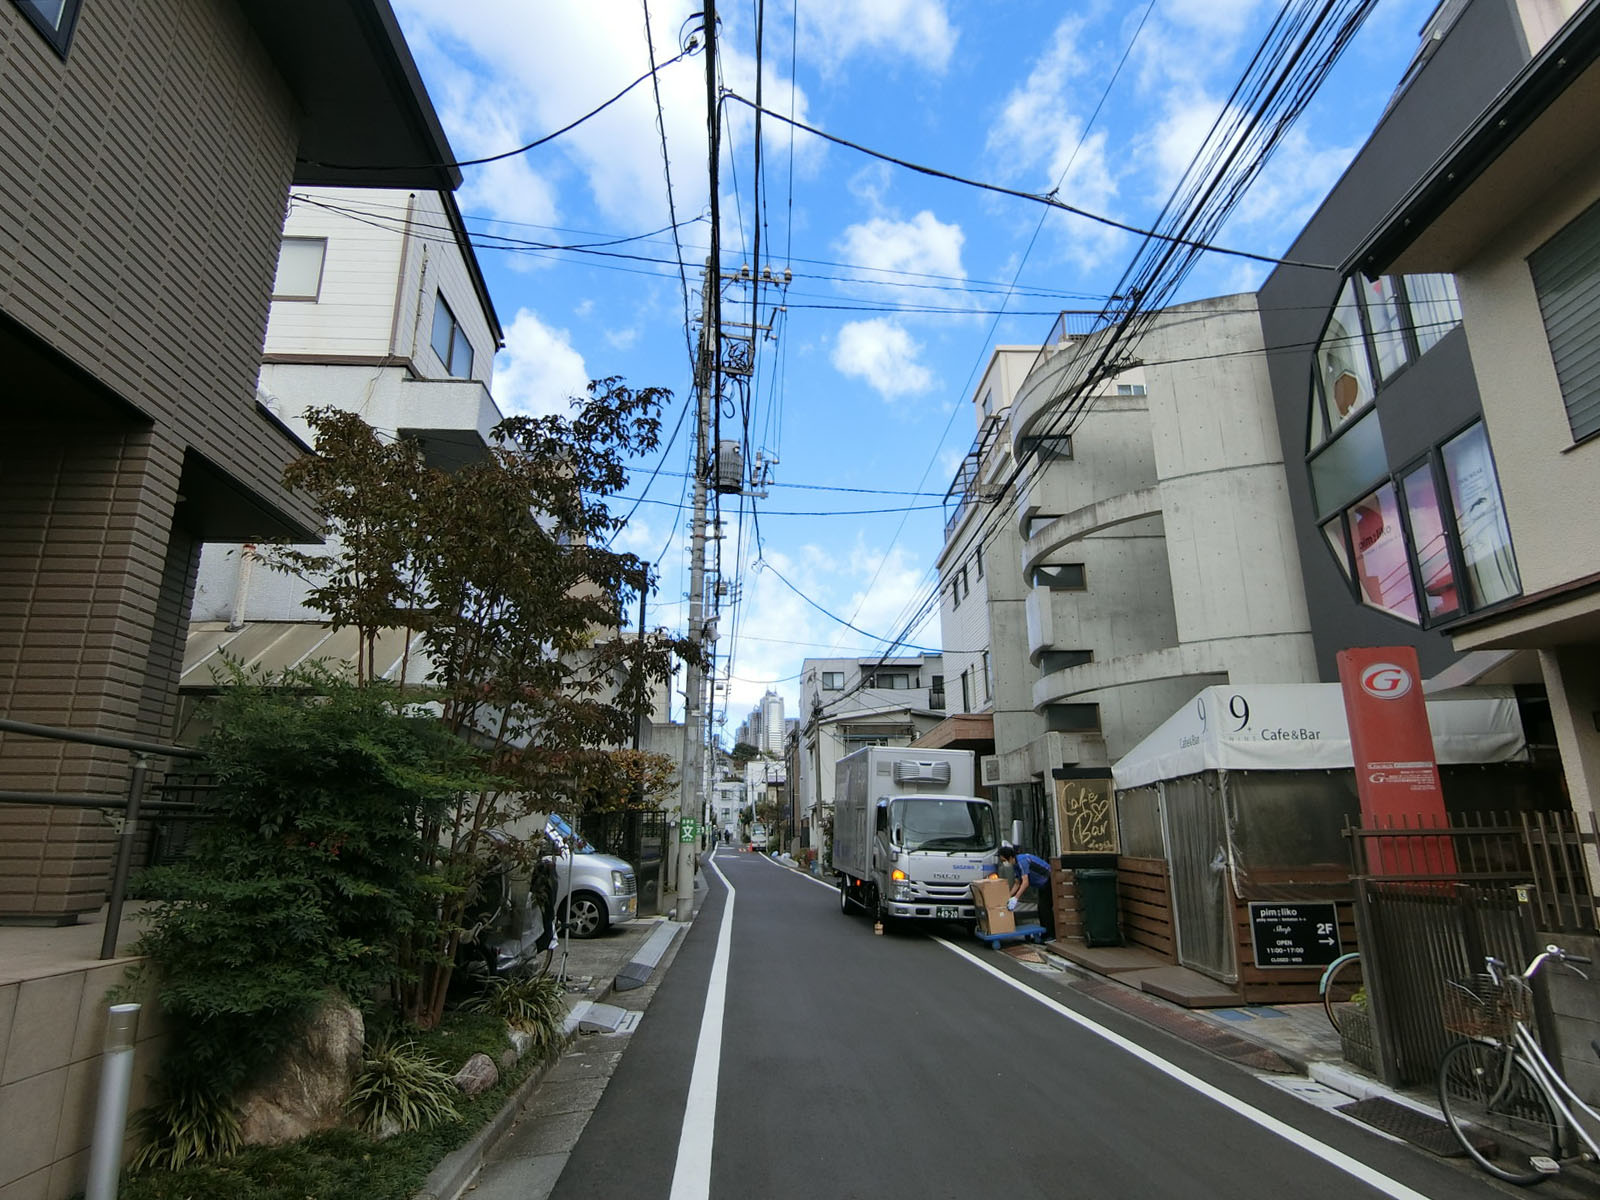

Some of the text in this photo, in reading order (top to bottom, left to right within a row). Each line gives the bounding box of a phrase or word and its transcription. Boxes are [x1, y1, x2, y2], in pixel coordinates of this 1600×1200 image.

[1261, 728, 1321, 740] Cafe&Bar
[681, 824, 693, 838] 文
[1072, 810, 1108, 844] Bar
[1316, 923, 1333, 934] 2F
